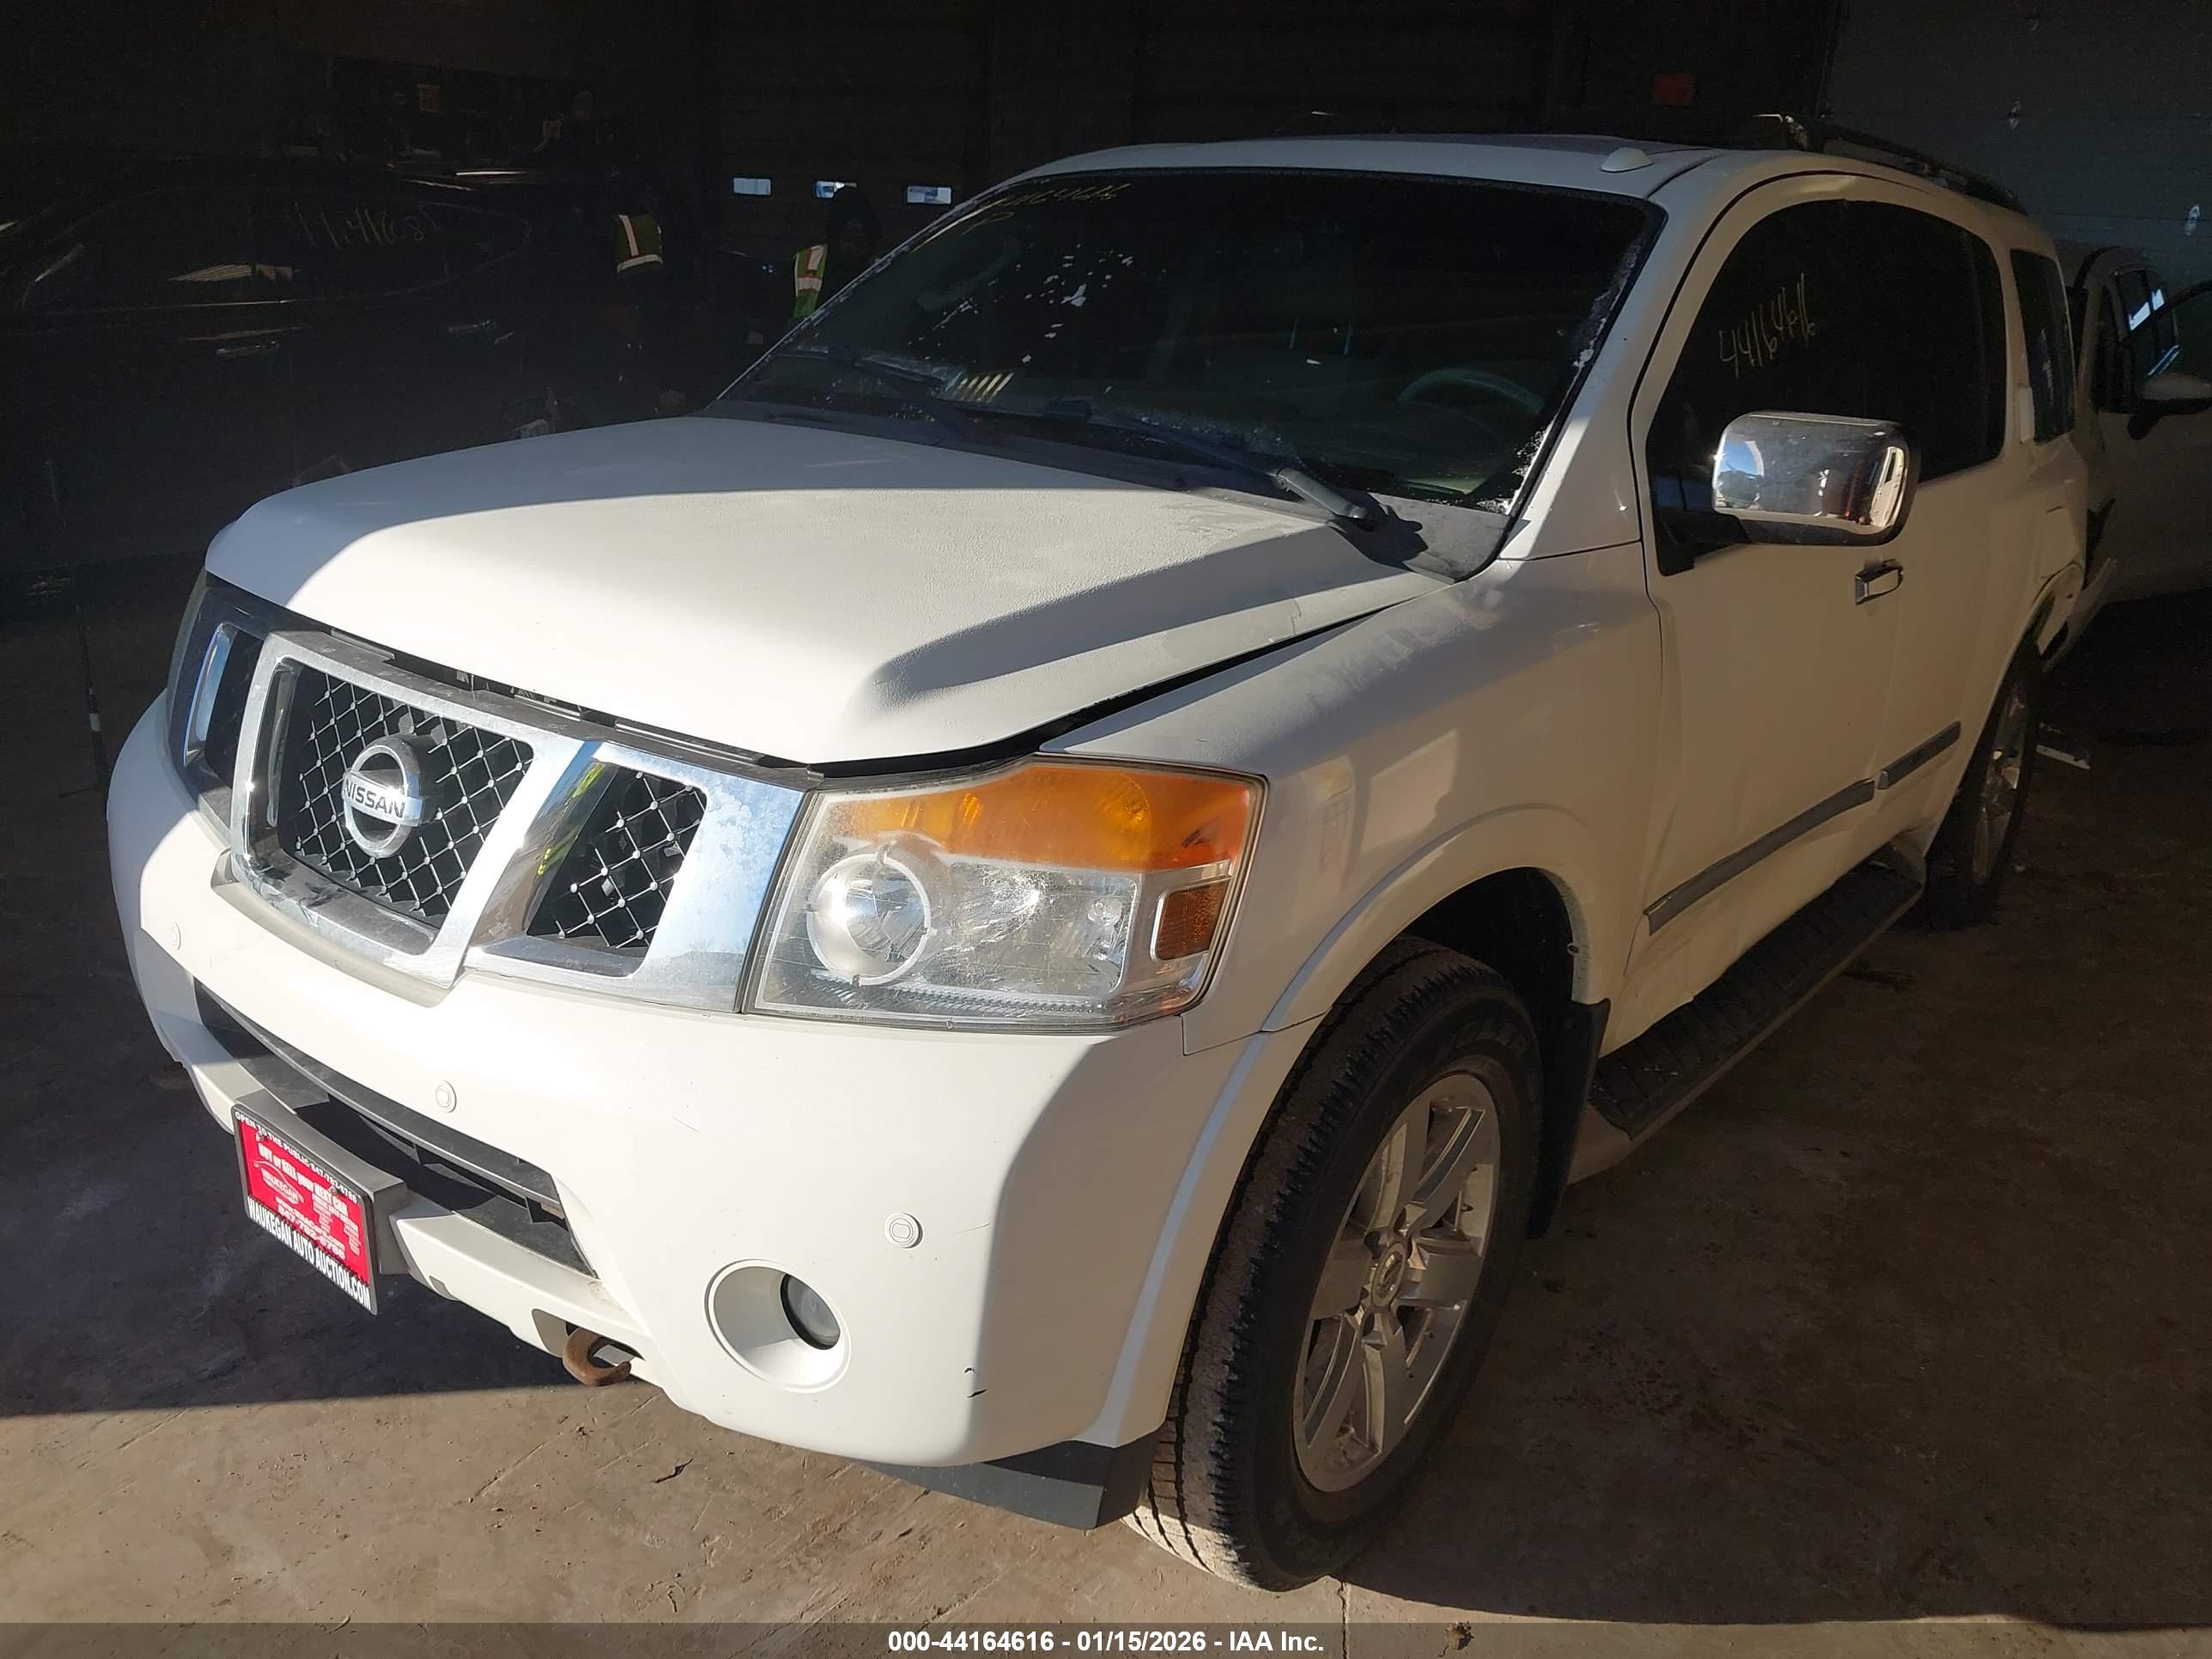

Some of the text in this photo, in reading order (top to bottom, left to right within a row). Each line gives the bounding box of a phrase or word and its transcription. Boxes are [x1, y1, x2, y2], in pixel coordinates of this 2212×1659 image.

[344, 778, 405, 818] NISSAN
[235, 1111, 257, 1129] OPEN
[247, 1195, 293, 1249] WAUKEGAN
[293, 1230, 315, 1265] AUTO
[315, 1247, 371, 1311] AUCTION.COM
